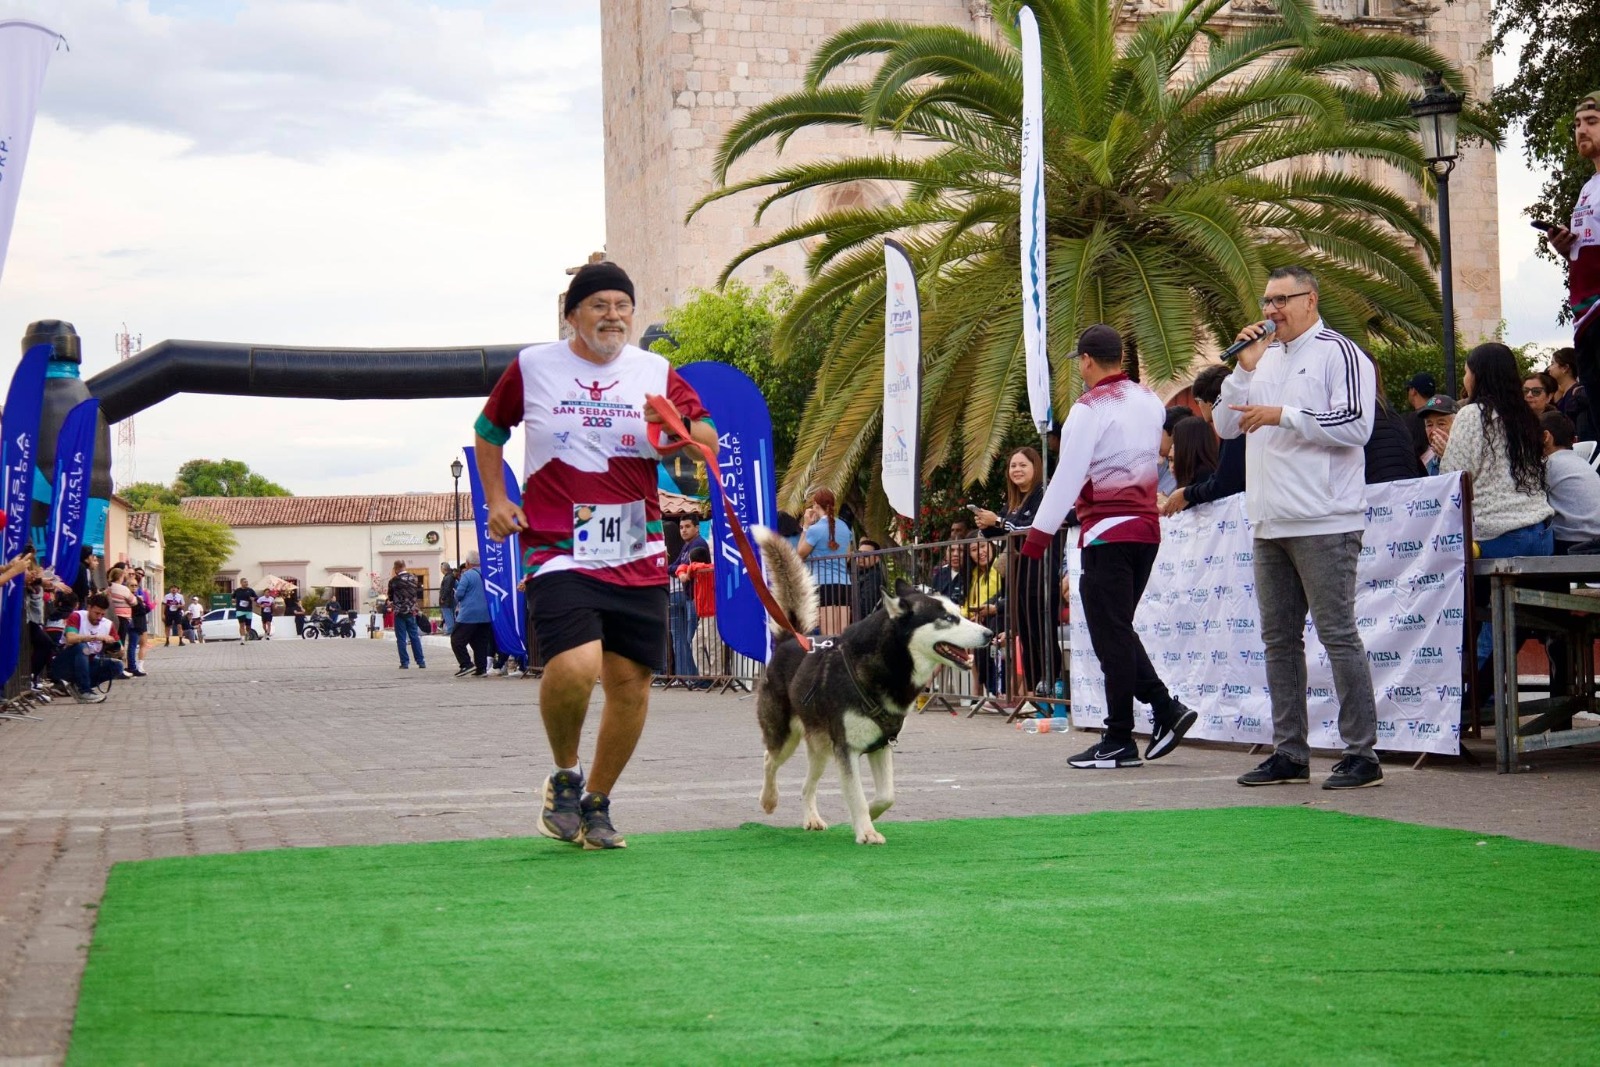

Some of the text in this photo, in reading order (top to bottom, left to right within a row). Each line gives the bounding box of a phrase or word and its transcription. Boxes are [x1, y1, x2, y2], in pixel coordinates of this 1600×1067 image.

[553, 406, 641, 419] SAN SEBASTIAN
[582, 416, 613, 428] 2026
[732, 431, 750, 534] SILVER CORP.
[7, 432, 26, 554] VIZSLA
[12, 433, 32, 551] SILVER CORP.
[1414, 499, 1442, 511] VIZSLA
[1373, 506, 1393, 517] VIZSLA
[599, 517, 621, 542] 141
[1440, 533, 1463, 545] VIZS
[1396, 541, 1423, 552] VIZSLA
[1441, 545, 1461, 553] SILVER
[496, 543, 504, 573] SILVE
[1416, 573, 1445, 585] VIZSLA
[1443, 608, 1463, 618] VIZSL
[1397, 614, 1426, 625] VIZSLA
[1371, 651, 1401, 661] VIZSLA
[1227, 685, 1252, 695] VIZSLA
[1394, 686, 1421, 696] VIZSLA
[1377, 721, 1395, 731] ZSLA
